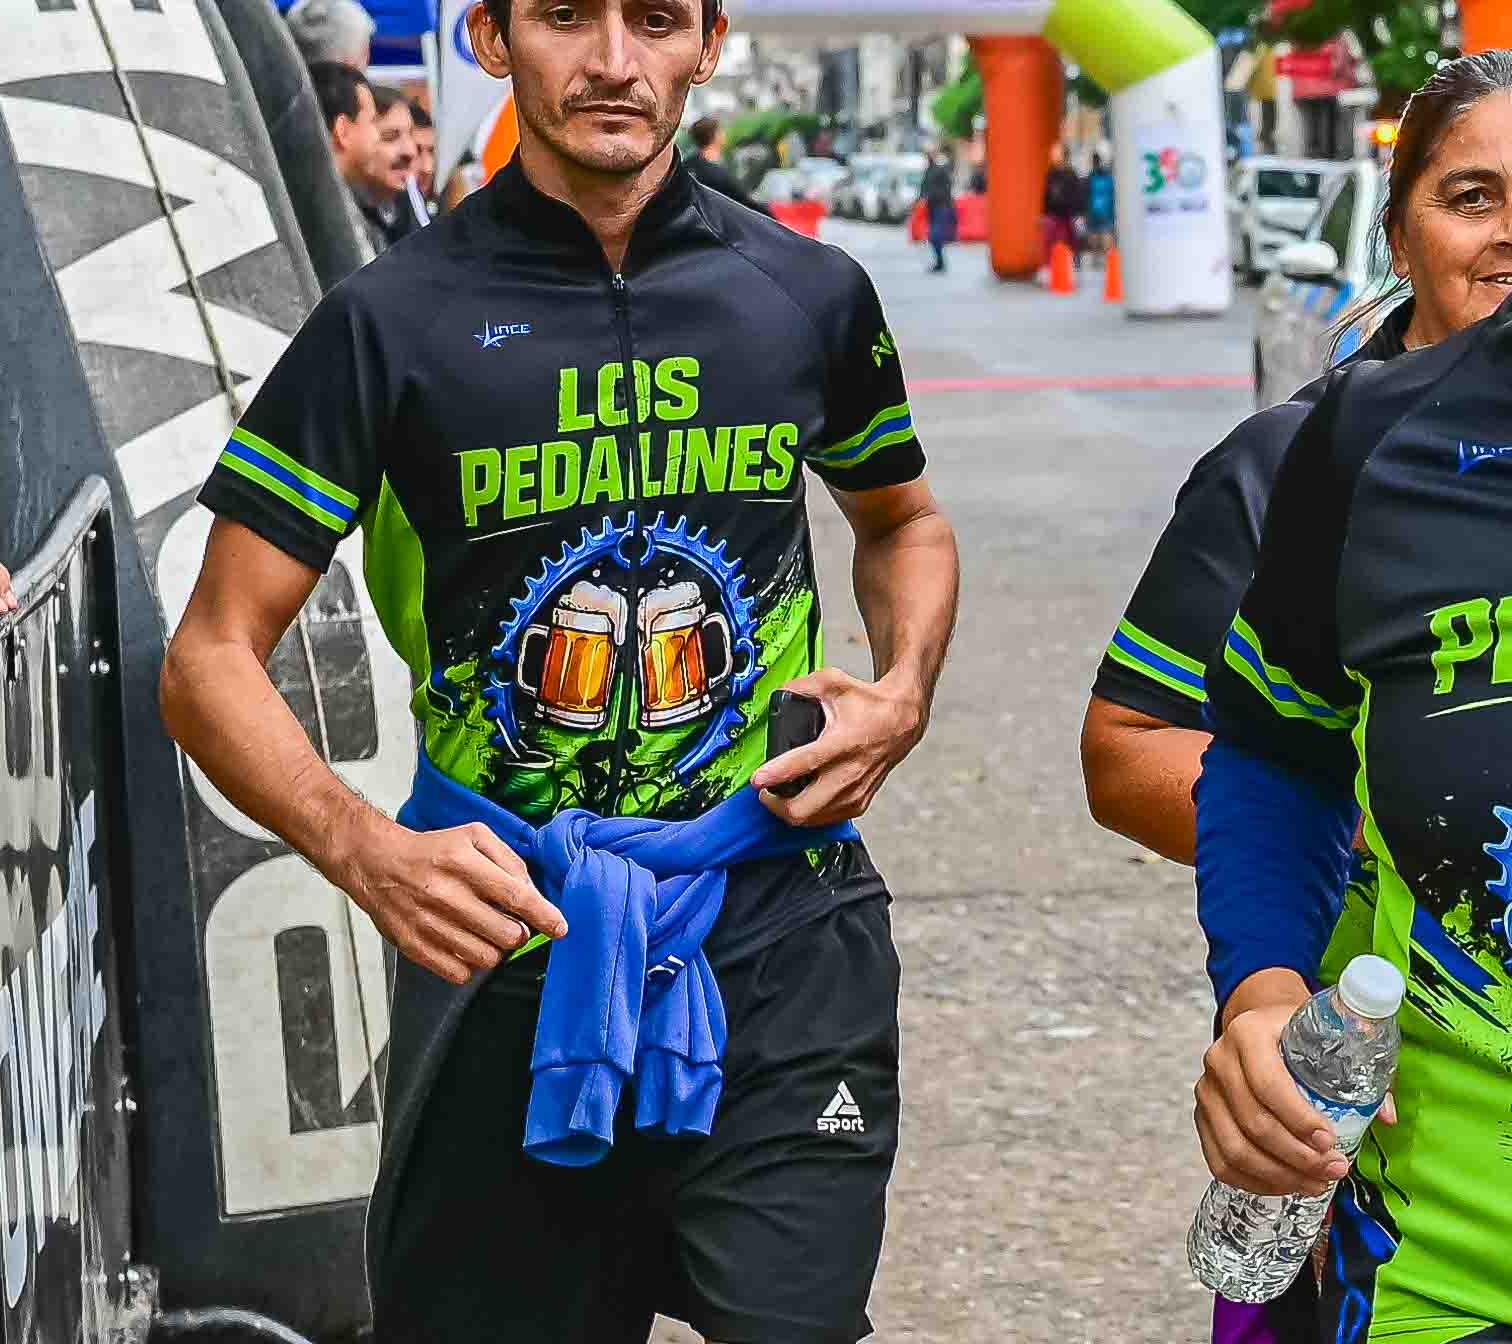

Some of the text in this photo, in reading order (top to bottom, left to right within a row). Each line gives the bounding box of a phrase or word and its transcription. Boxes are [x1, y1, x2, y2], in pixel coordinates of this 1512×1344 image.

[556, 355, 700, 433] LOS
[458, 421, 799, 528] PEDALINES
[816, 1116, 865, 1134] sport
